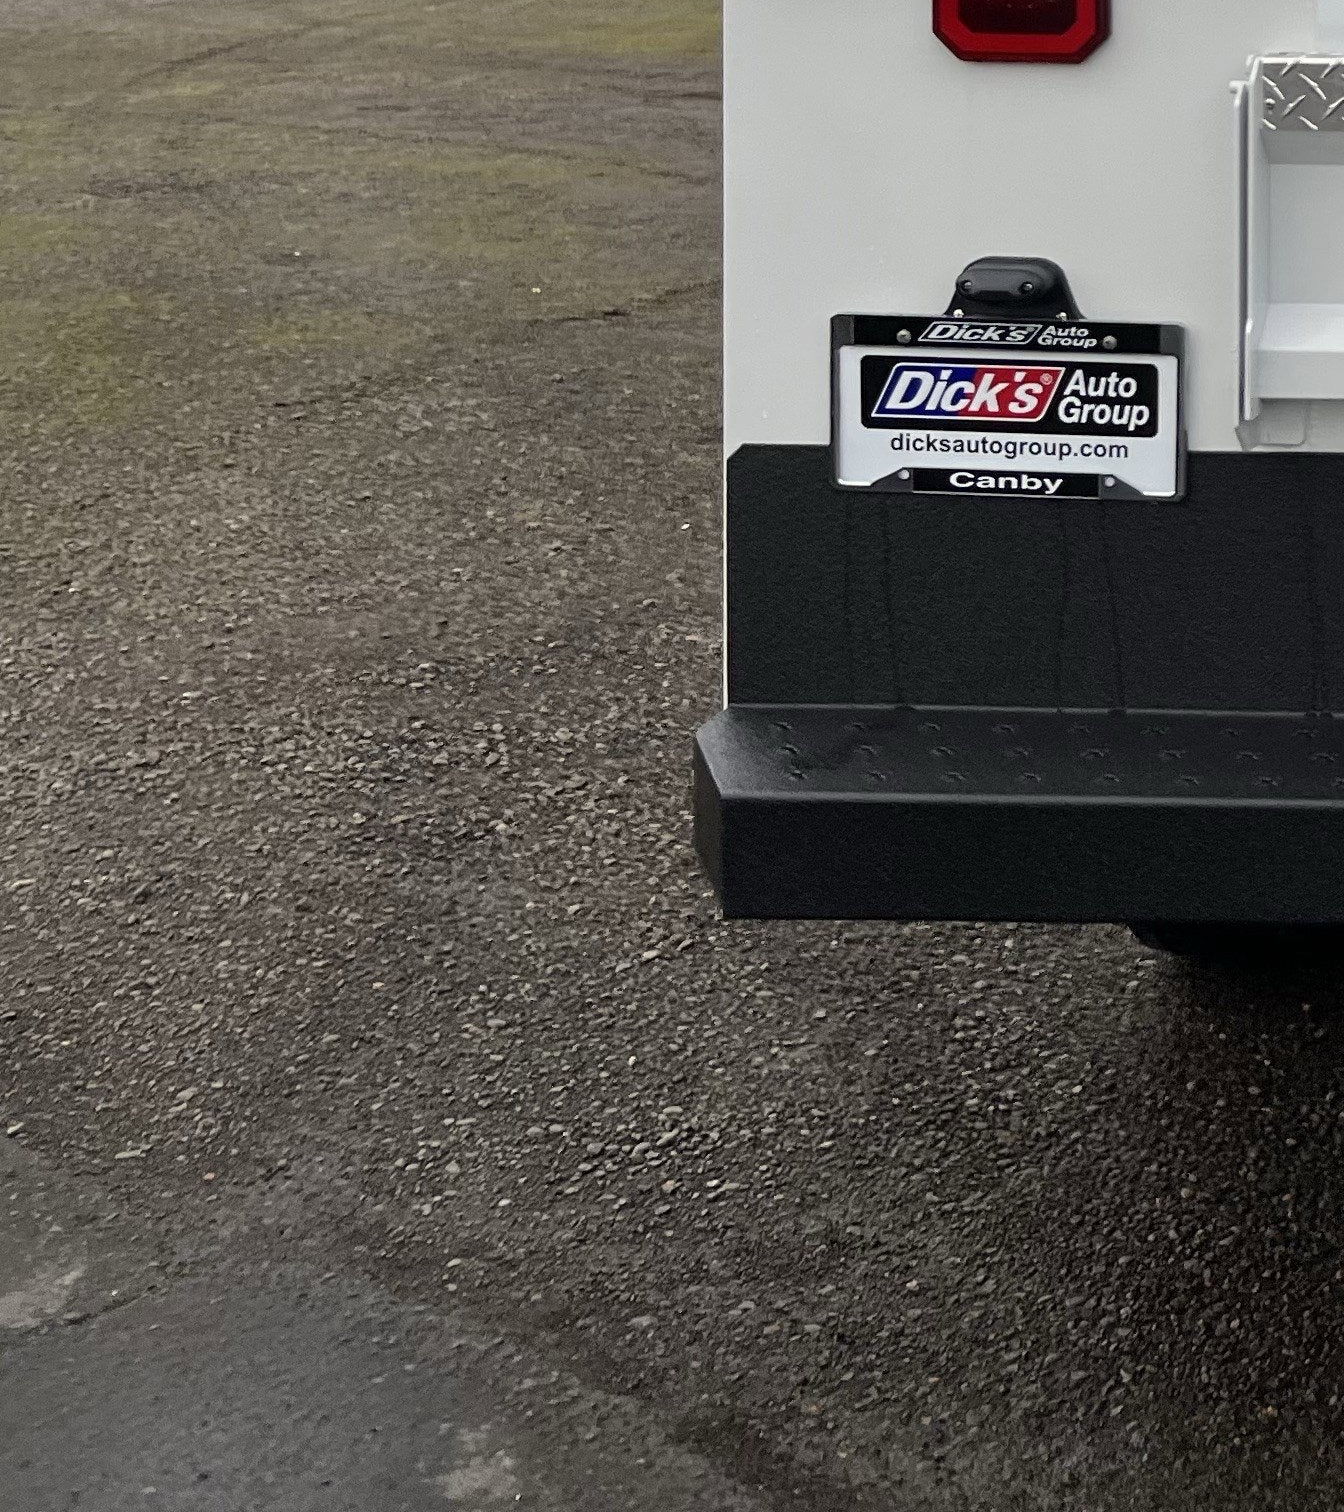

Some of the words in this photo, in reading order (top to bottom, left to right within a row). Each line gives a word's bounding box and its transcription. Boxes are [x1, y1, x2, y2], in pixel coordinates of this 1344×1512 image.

[928, 323, 1030, 342] Dick's
[1037, 336, 1097, 348] Group
[1043, 326, 1089, 337] Auto
[885, 369, 1043, 414] Dick's
[1063, 369, 1137, 397] Auto
[1057, 396, 1150, 430] Group
[890, 432, 1129, 460] dicksautogroup.com
[949, 471, 1063, 494] Canby
